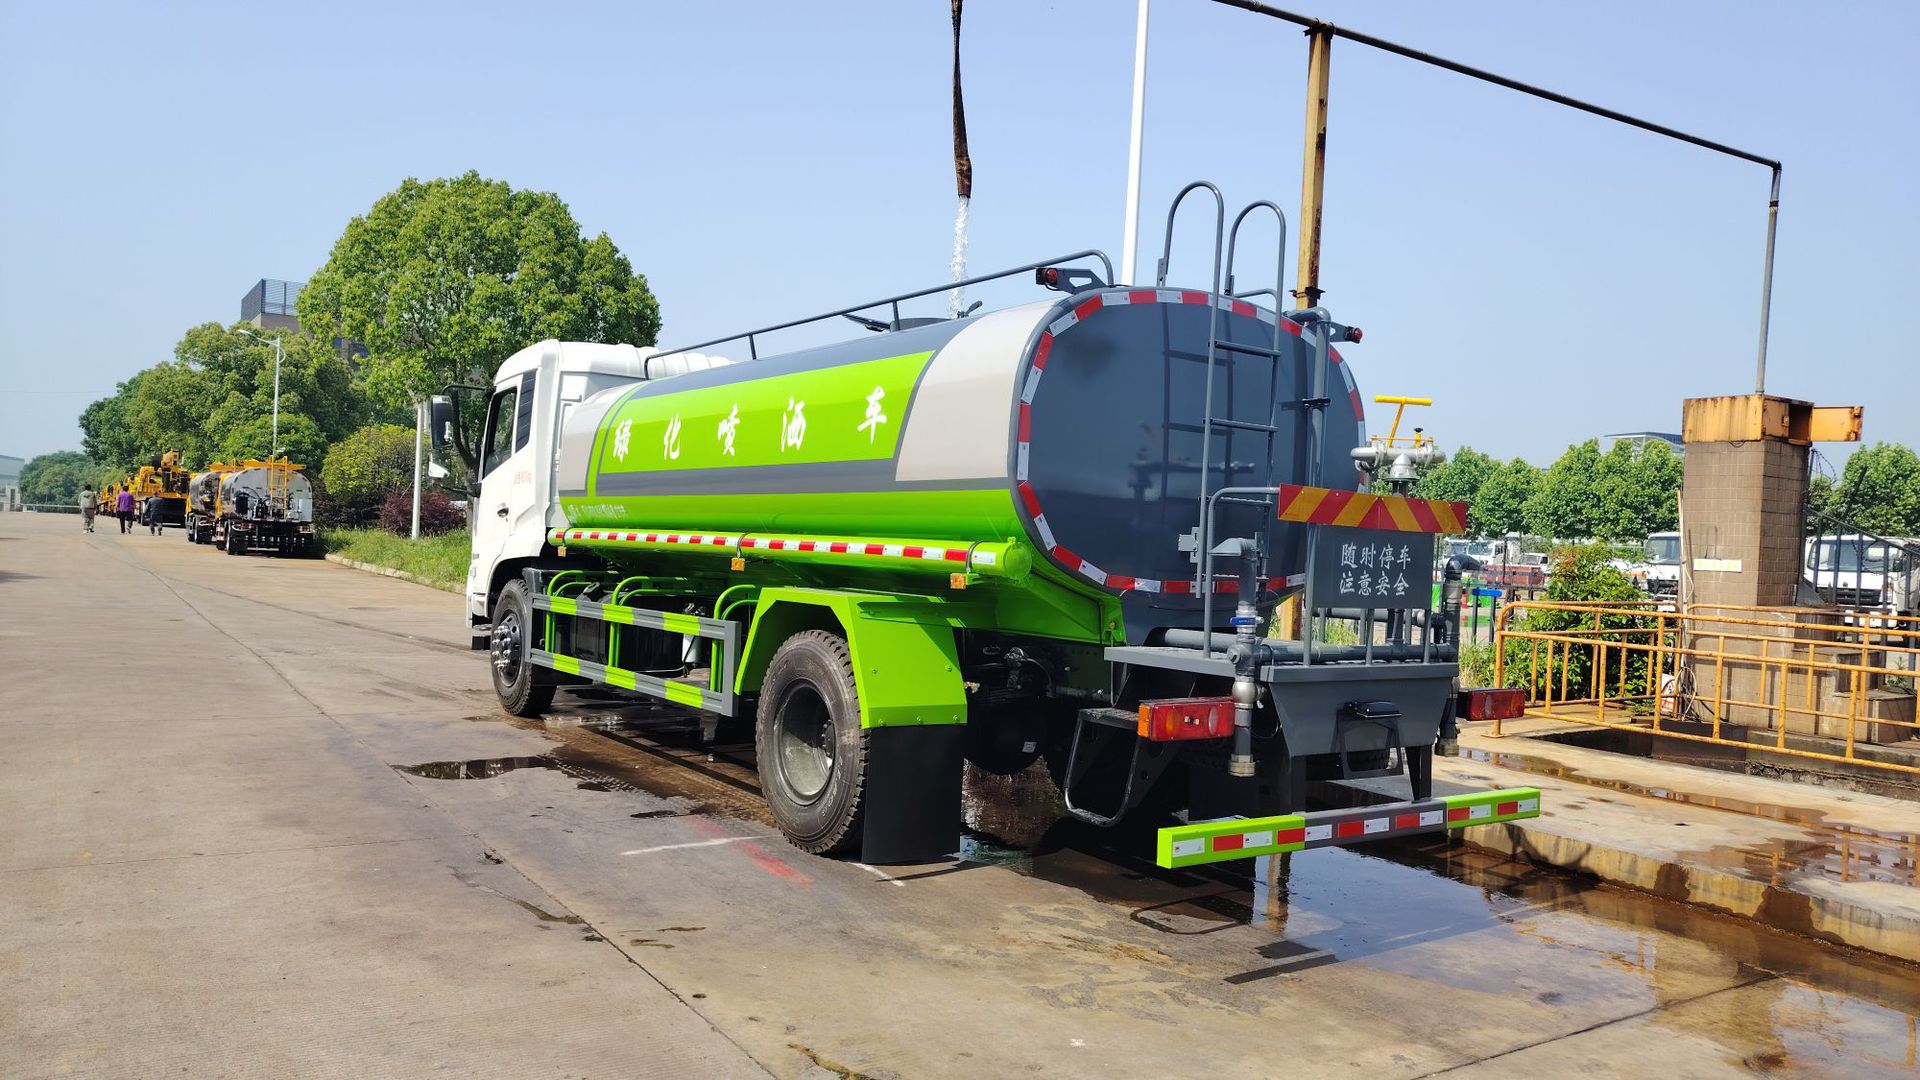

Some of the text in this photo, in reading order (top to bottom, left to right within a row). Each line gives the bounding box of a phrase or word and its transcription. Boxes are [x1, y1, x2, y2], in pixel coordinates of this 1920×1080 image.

[613, 385, 887, 463] 绿化喷洒车
[1341, 541, 1411, 570] 随时停车
[1339, 570, 1409, 596] 注意安全
